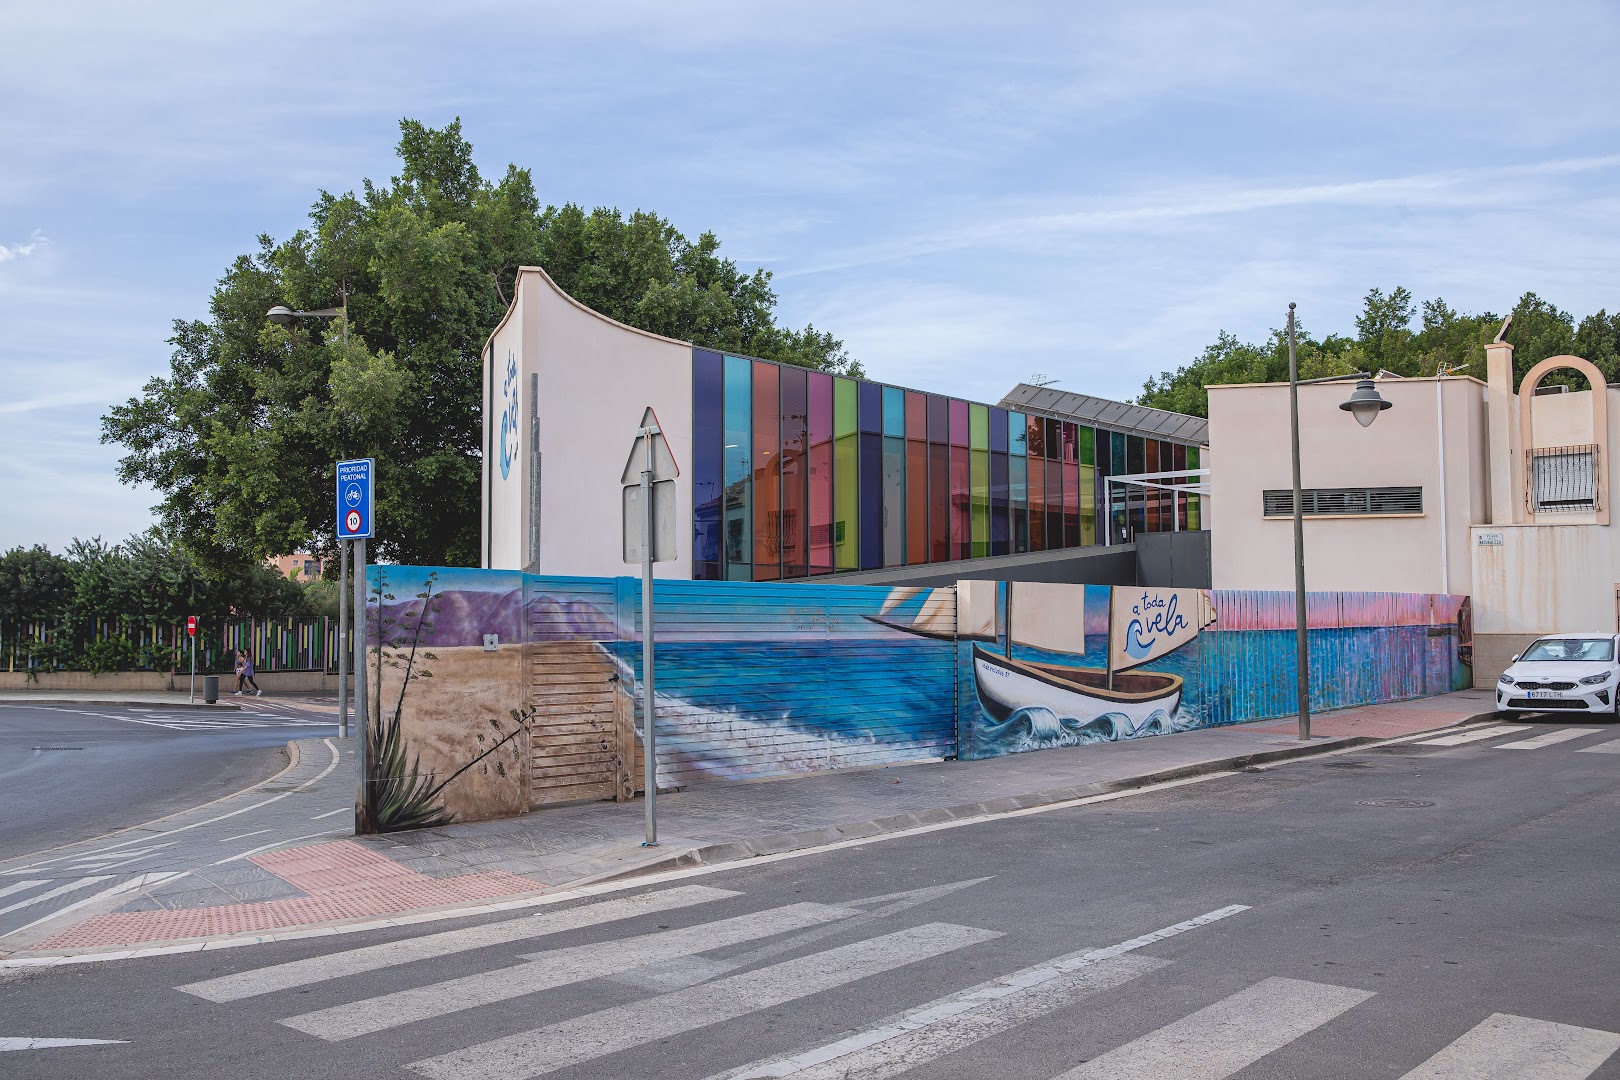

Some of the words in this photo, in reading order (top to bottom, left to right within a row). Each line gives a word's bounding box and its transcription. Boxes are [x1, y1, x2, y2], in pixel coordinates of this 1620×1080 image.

[339, 464, 368, 474] PRIORIDAD
[340, 473, 367, 482] PEATONAL
[350, 517, 357, 526] 10
[1132, 605, 1141, 616] a
[1141, 591, 1167, 611] toda
[1146, 593, 1189, 637] vela
